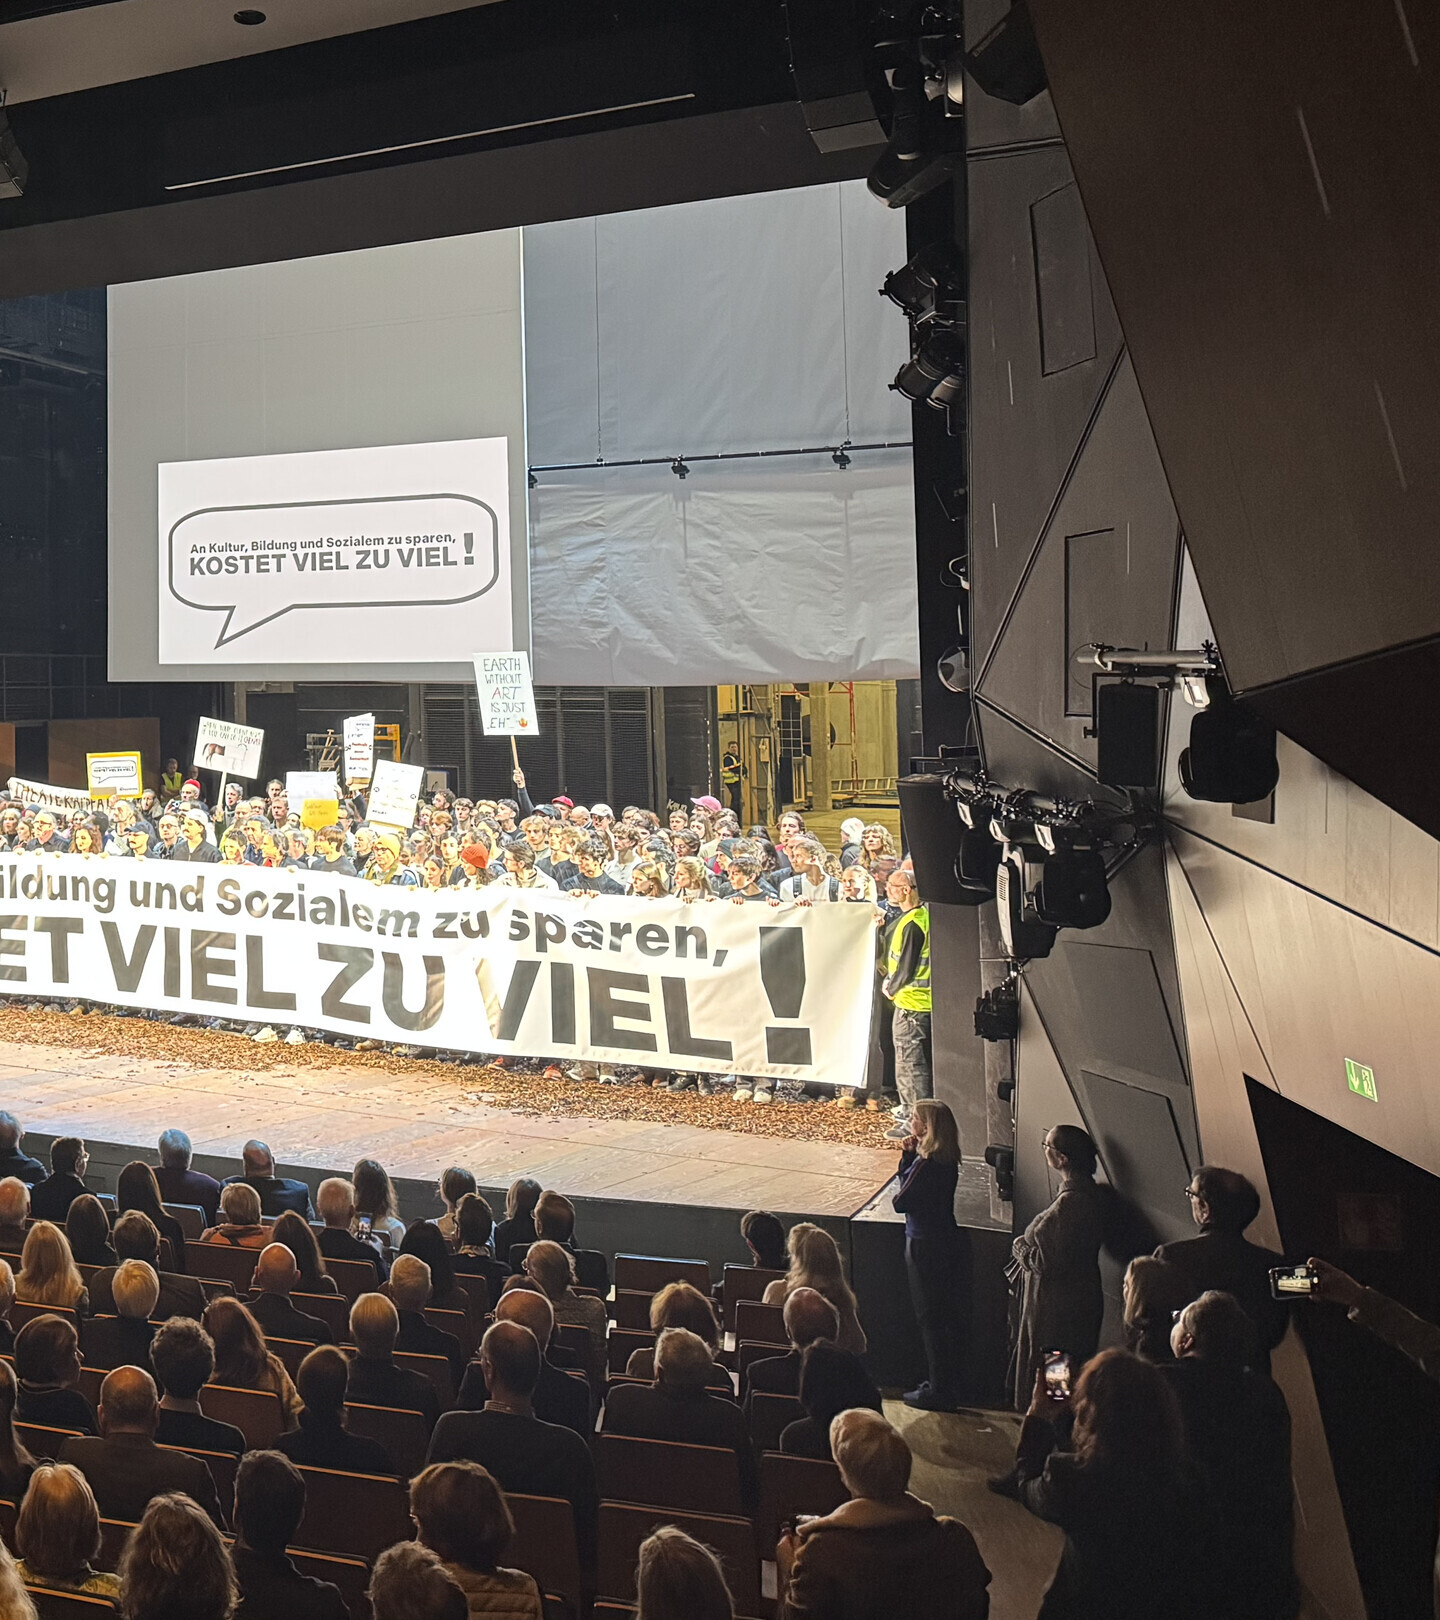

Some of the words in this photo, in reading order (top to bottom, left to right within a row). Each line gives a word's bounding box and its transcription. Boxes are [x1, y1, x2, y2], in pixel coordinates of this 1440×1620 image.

[190, 543, 206, 554] An
[209, 541, 248, 554] Kultur,
[251, 540, 296, 552] Bildung
[300, 538, 323, 549] und
[326, 536, 384, 547] Sozialem
[387, 536, 402, 545] zu
[405, 533, 456, 546] sparen,
[190, 553, 286, 576] KOSTET
[292, 551, 349, 572] VIEL
[356, 549, 390, 570] ZU
[397, 546, 458, 568] VIEL
[483, 658, 521, 672] EARTH
[485, 673, 522, 684] WITHOUT
[492, 686, 522, 700] ART
[490, 702, 500, 713] IS
[502, 702, 526, 713] JUST
[130, 875, 204, 913] und
[217, 879, 419, 938] Sozialem
[432, 910, 490, 939] zu
[508, 908, 729, 968] sparen,
[100, 920, 297, 1010] VIEL
[317, 942, 445, 1032] ZU
[475, 956, 733, 1062] VIEL
